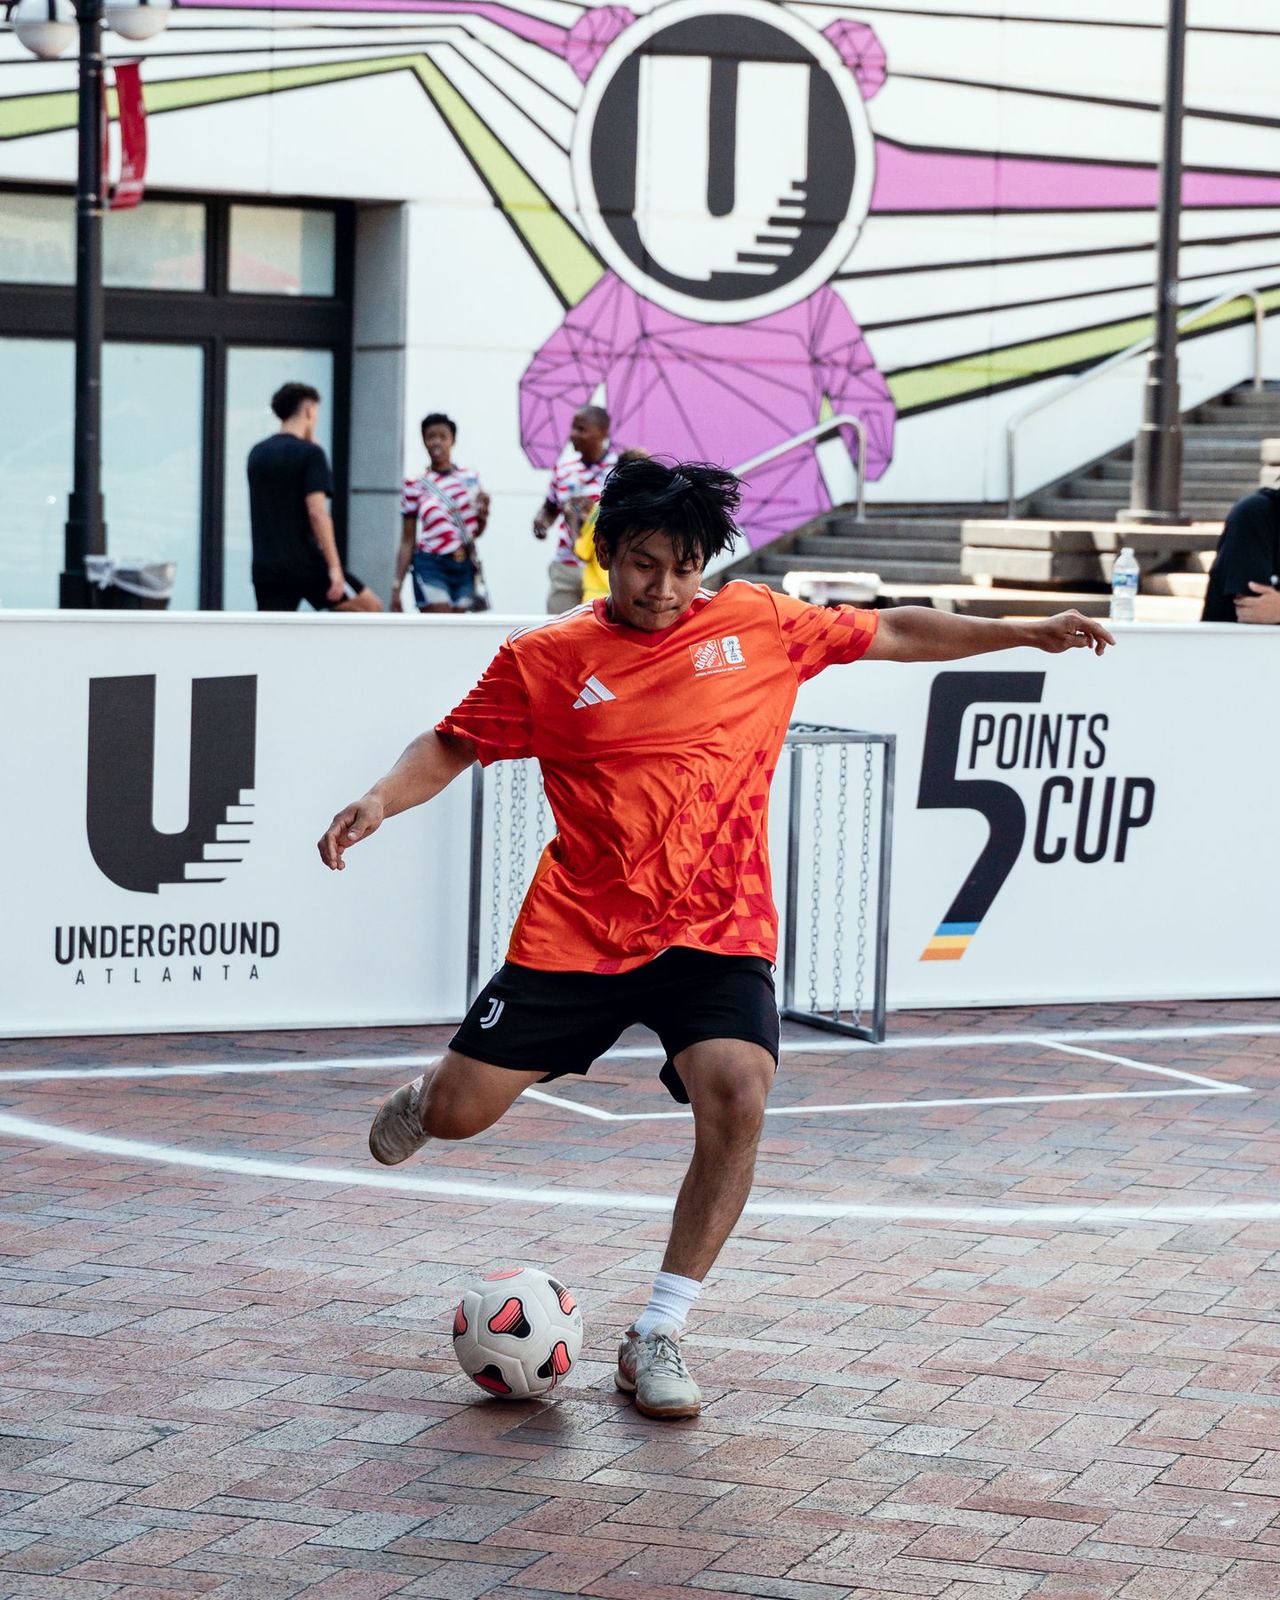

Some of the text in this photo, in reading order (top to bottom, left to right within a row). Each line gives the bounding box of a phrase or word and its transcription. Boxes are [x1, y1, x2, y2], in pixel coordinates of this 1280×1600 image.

[633, 54, 811, 281] U
[87, 674, 258, 895] U
[916, 671, 1109, 961] 5 POINTS
[1033, 775, 1156, 864] CUP
[55, 921, 280, 965] UNDERGROUND
[75, 964, 259, 985] ATLANTA
